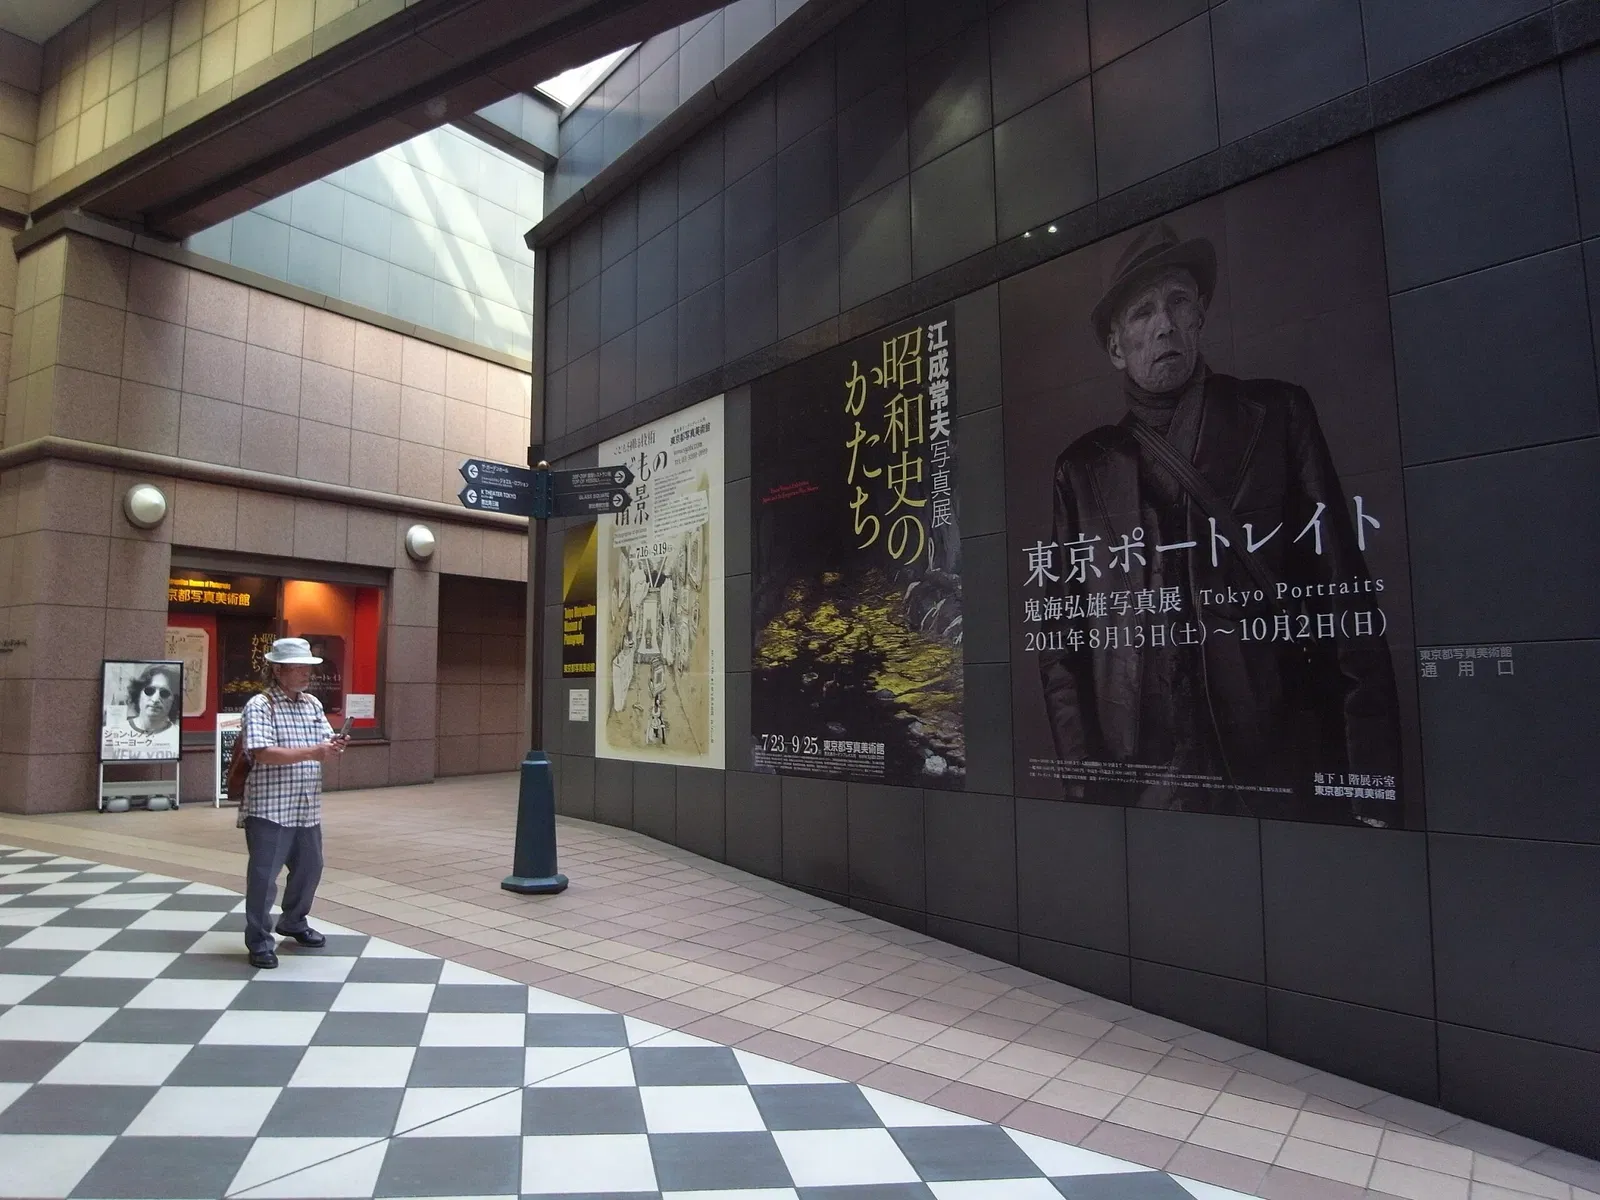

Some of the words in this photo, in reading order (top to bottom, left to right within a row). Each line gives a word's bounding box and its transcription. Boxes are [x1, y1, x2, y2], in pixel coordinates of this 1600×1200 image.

[927, 320, 952, 528] 江成常夫写真展
[845, 360, 884, 550] かたち
[882, 326, 927, 566] 昭和史の
[1022, 495, 1381, 588] 東京ポートレイト
[1023, 586, 1182, 624] 鬼海弘雄写真展
[1200, 587, 1264, 607] Tokyo
[1275, 578, 1385, 600] Portraits
[1420, 646, 1513, 661] 東京都写真美術館
[1421, 659, 1514, 678] 通用口
[105, 739, 153, 747] ニューヨーク
[823, 739, 885, 755] 東京都写真美術館
[1314, 785, 1396, 801] 東京都写真美術館
